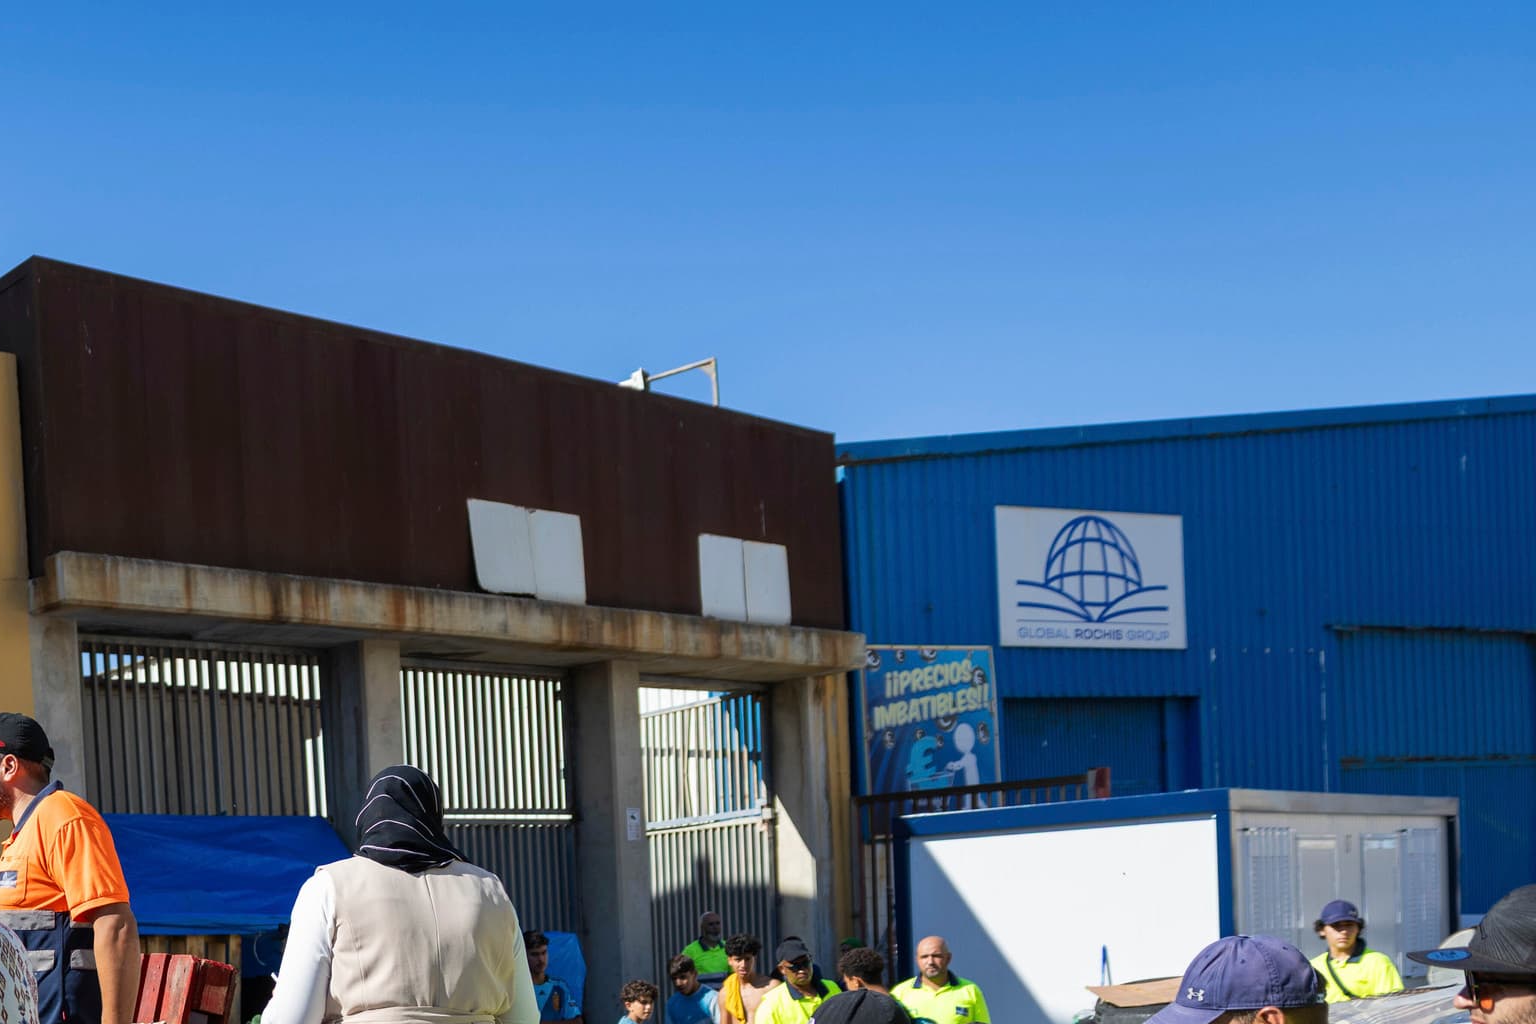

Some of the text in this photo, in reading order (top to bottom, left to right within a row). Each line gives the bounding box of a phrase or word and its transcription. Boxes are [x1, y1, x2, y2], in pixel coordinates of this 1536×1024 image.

[1018, 626, 1170, 642] GLOBAL ROCHIS GROUP
